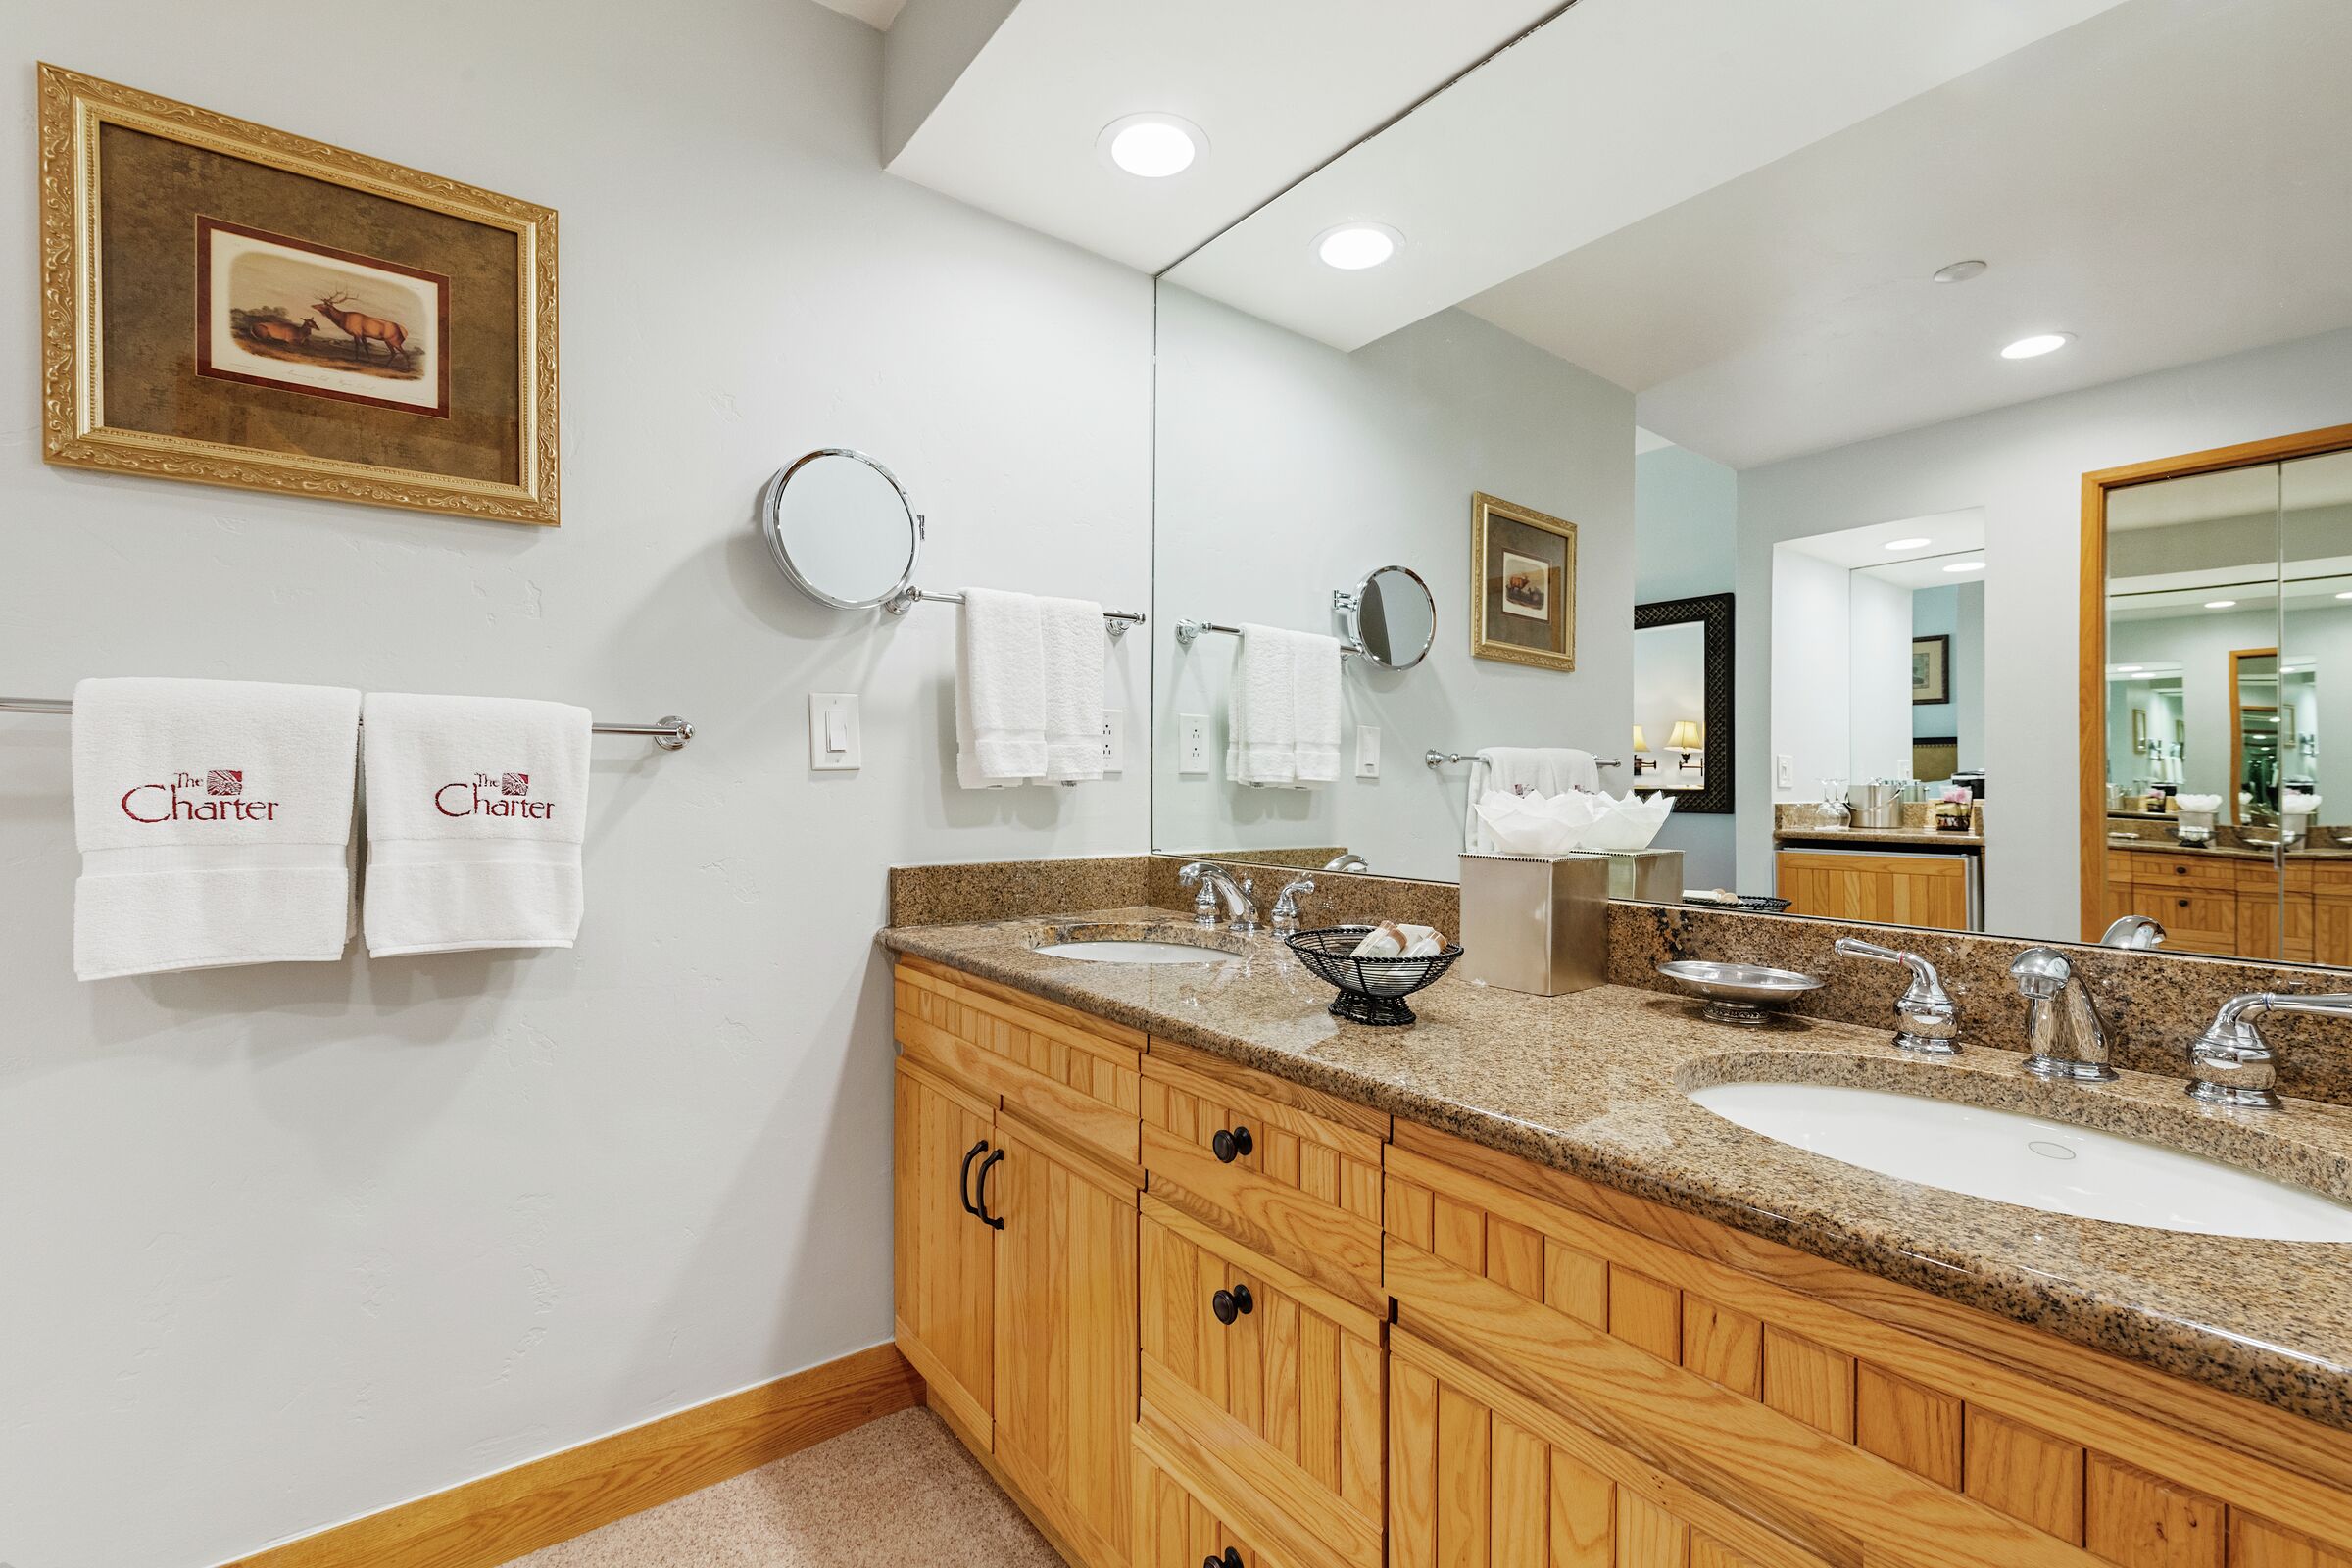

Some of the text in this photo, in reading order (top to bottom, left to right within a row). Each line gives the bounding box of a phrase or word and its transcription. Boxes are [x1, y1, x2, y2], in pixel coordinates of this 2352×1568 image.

[173, 772, 204, 788] The
[474, 772, 500, 788] The
[121, 783, 279, 824] Charter
[434, 783, 555, 819] Charter
